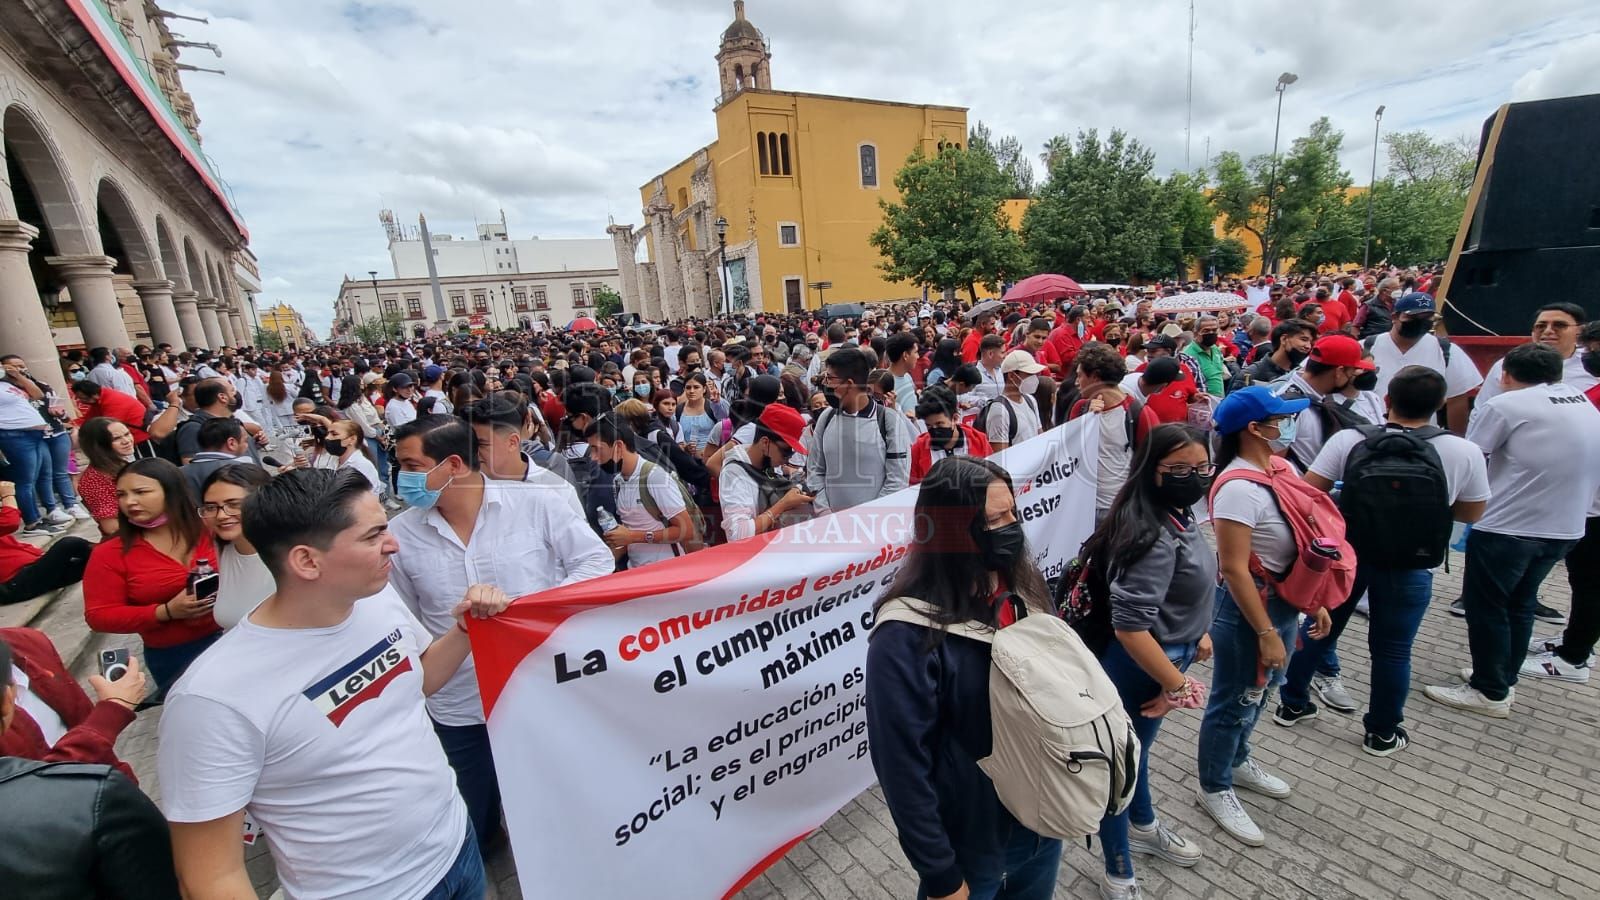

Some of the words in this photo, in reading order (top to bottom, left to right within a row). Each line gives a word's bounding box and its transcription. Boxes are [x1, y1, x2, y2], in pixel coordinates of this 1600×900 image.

[554, 650, 608, 684] La
[618, 577, 807, 661] comunidad
[653, 655, 687, 693] el
[696, 580, 875, 675] cumplimiento
[881, 566, 899, 586] d
[760, 621, 856, 689] máxima
[708, 684, 836, 753] educación
[842, 667, 864, 689] es
[615, 774, 701, 846] social;
[710, 758, 741, 782] es
[749, 739, 770, 765] el
[710, 795, 725, 821] y
[733, 775, 755, 801] el
